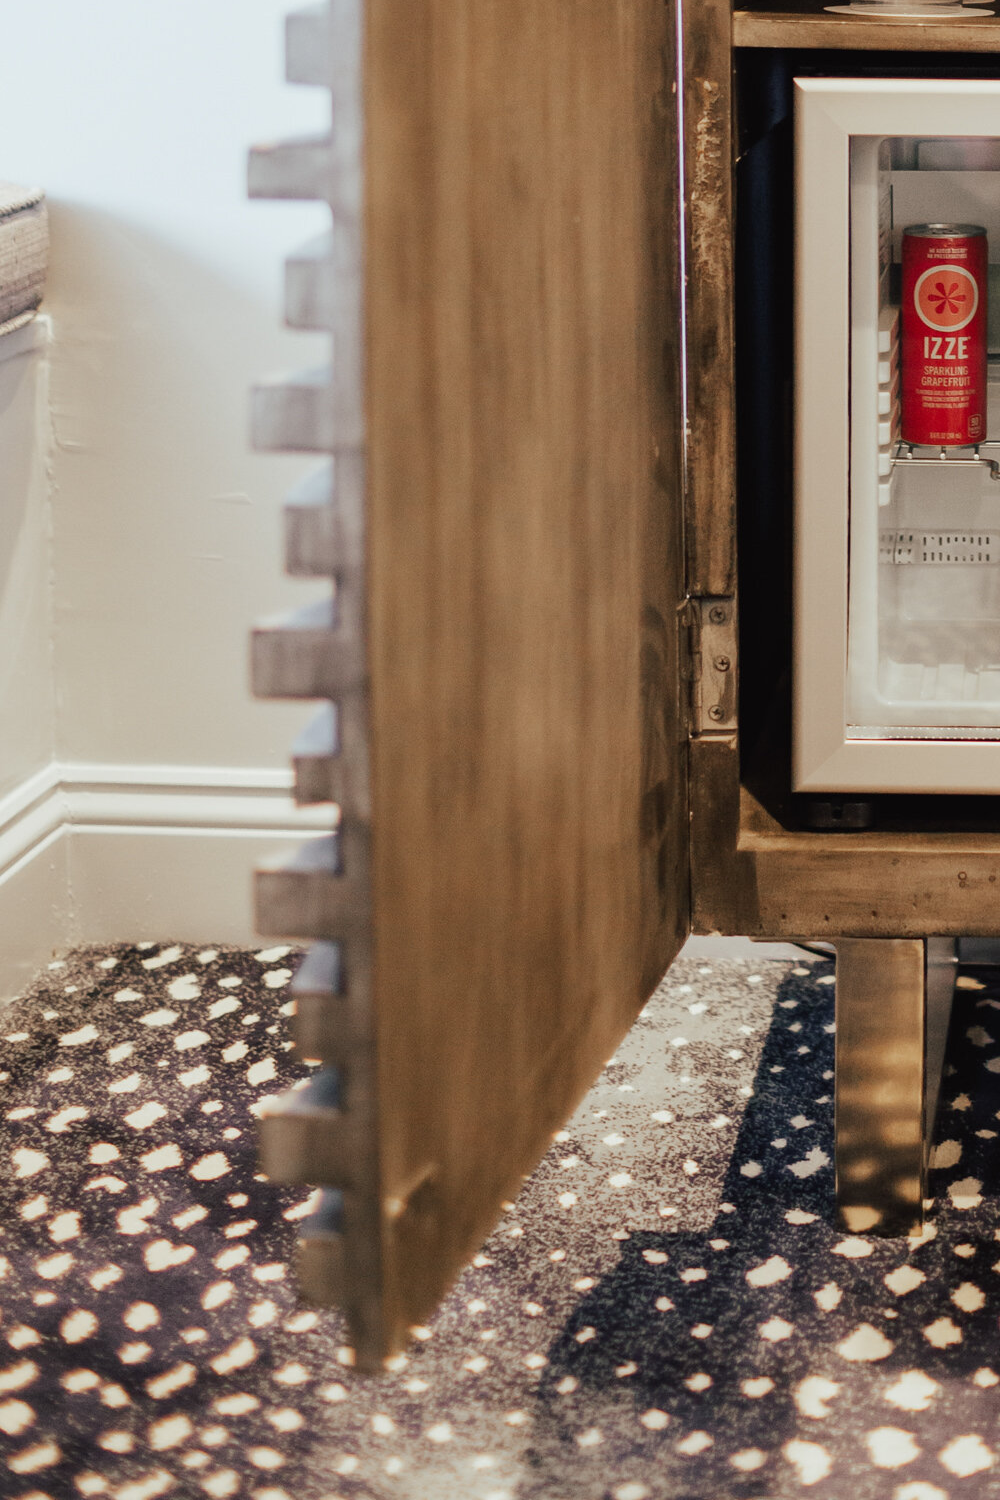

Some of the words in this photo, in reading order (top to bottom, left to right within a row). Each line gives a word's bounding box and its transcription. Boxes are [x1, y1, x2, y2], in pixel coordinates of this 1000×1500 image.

[923, 336, 969, 360] IZZE
[923, 365, 969, 376] SPARKLING
[921, 376, 971, 387] GRAPEFRUIT
